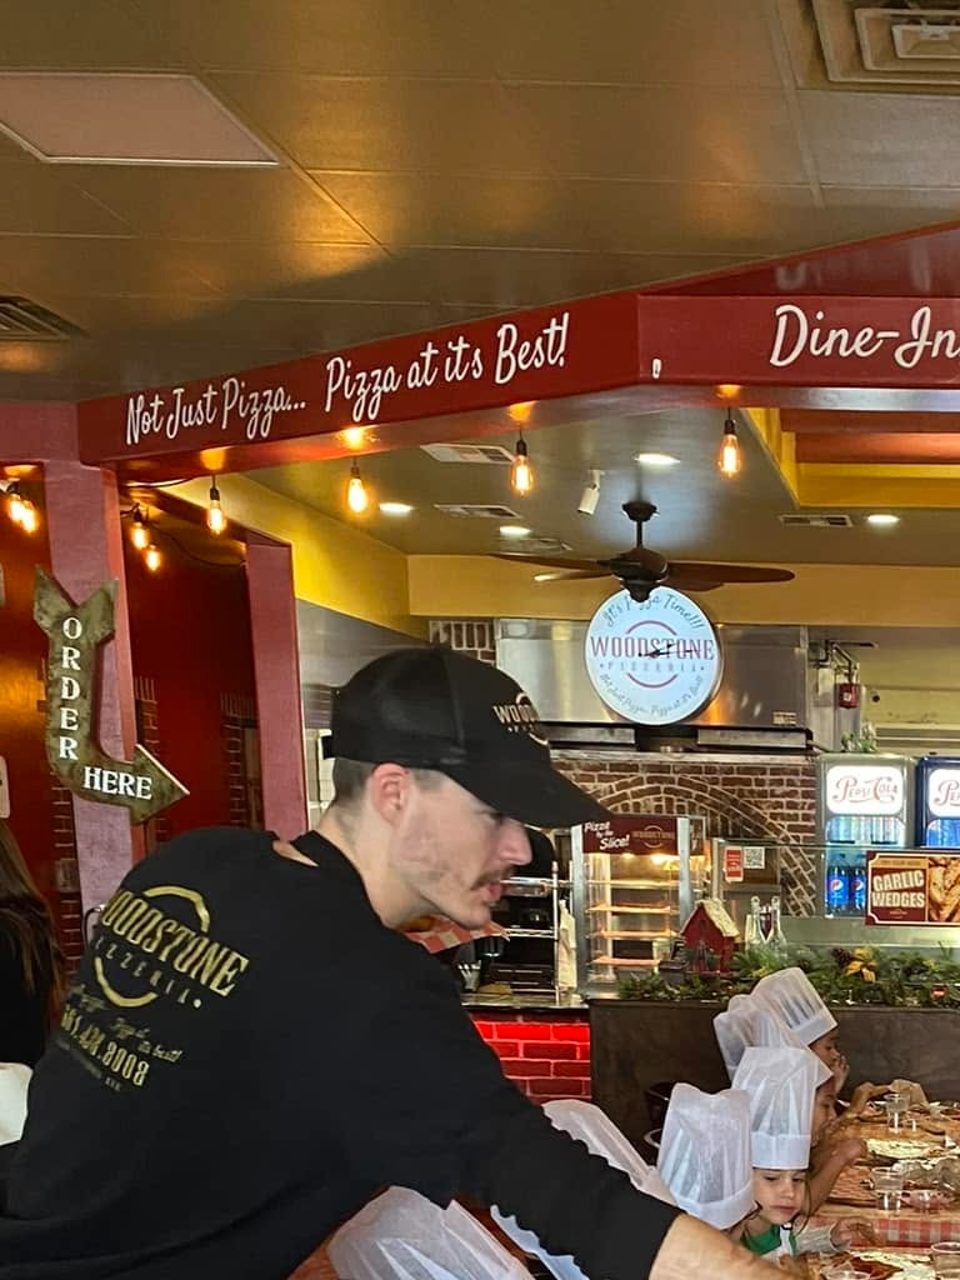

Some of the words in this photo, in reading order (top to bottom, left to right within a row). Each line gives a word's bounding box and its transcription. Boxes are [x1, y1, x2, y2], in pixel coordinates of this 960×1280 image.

[126, 397, 164, 446] Not
[165, 387, 218, 439] Just
[222, 377, 306, 440] Pizza...
[326, 357, 401, 422] Pizza
[406, 342, 438, 389] at
[445, 335, 483, 382] its
[495, 312, 571, 385] Best!
[590, 635, 715, 661] WOODSTONE
[59, 617, 82, 761] ORDER
[84, 766, 153, 801] HERE
[873, 870, 925, 892] GARLIC
[871, 891, 926, 908] WEDGES
